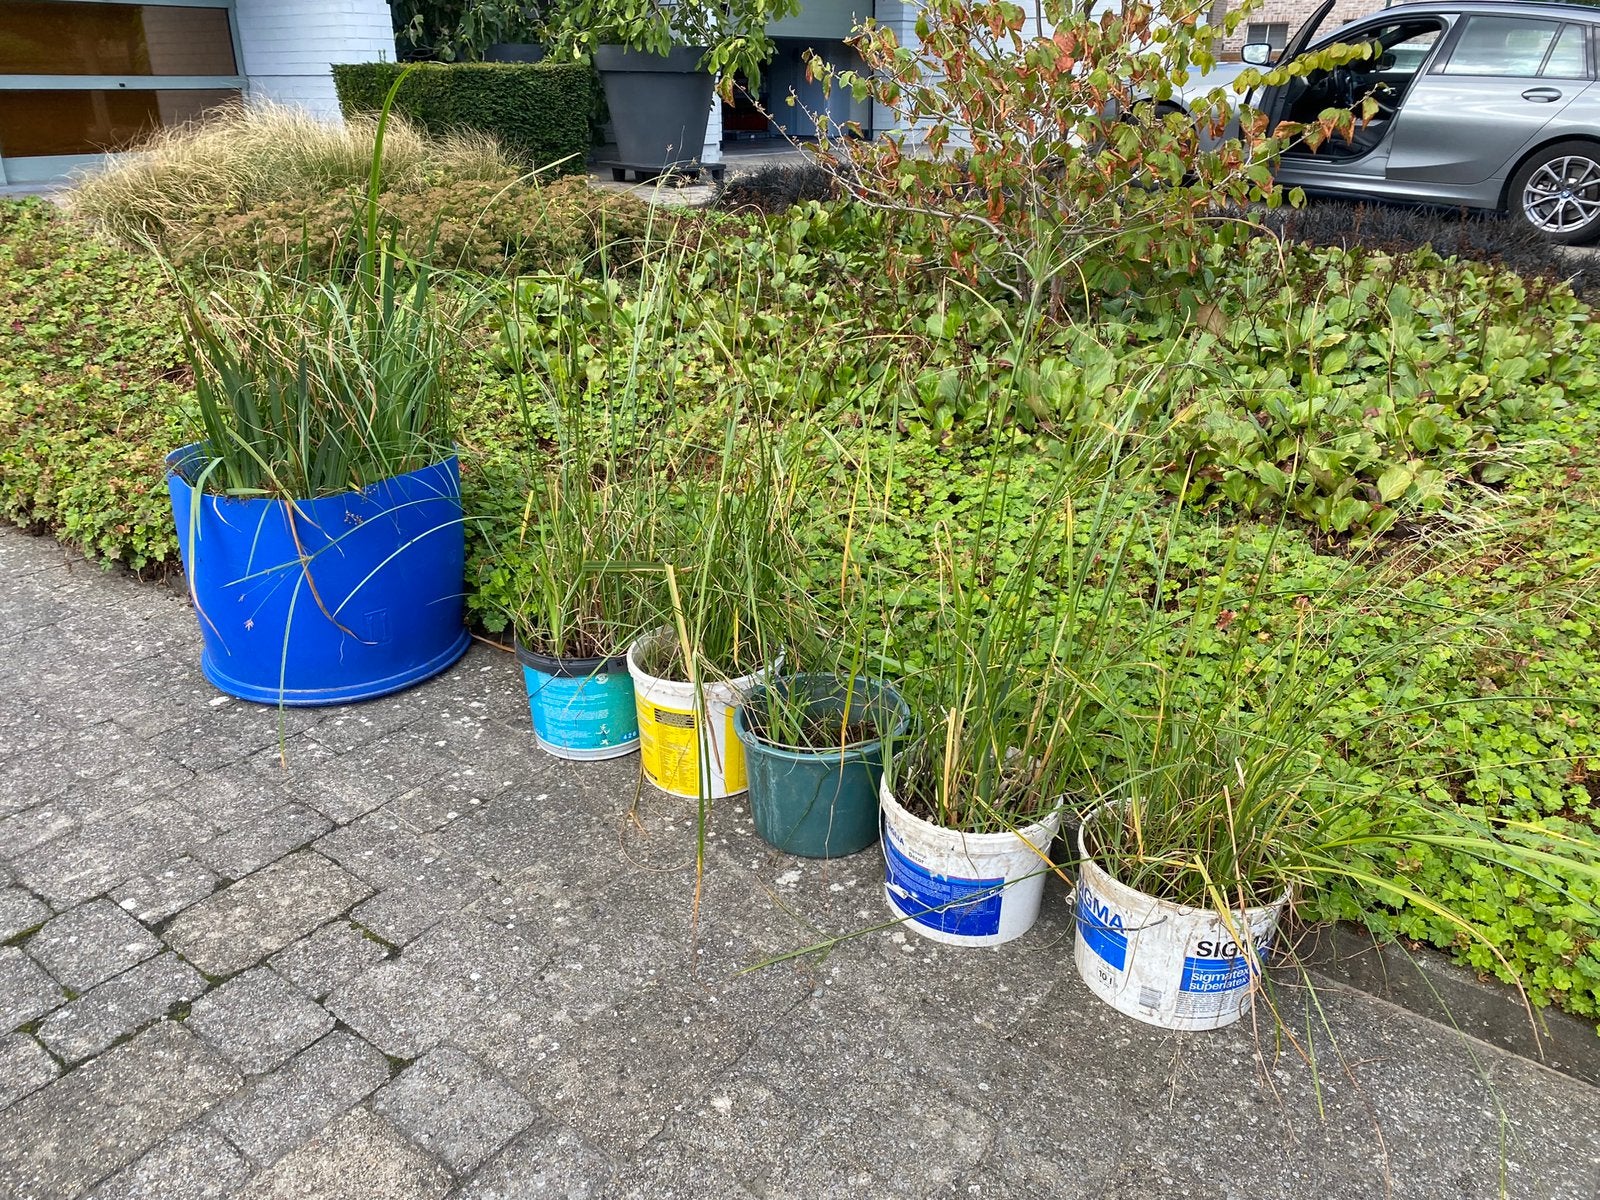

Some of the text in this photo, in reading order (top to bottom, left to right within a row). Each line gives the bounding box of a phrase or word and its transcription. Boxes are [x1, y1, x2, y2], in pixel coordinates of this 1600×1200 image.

[1098, 969, 1108, 981] 10
[1191, 967, 1250, 984] sigmatex
[1189, 977, 1248, 992] superlatex
